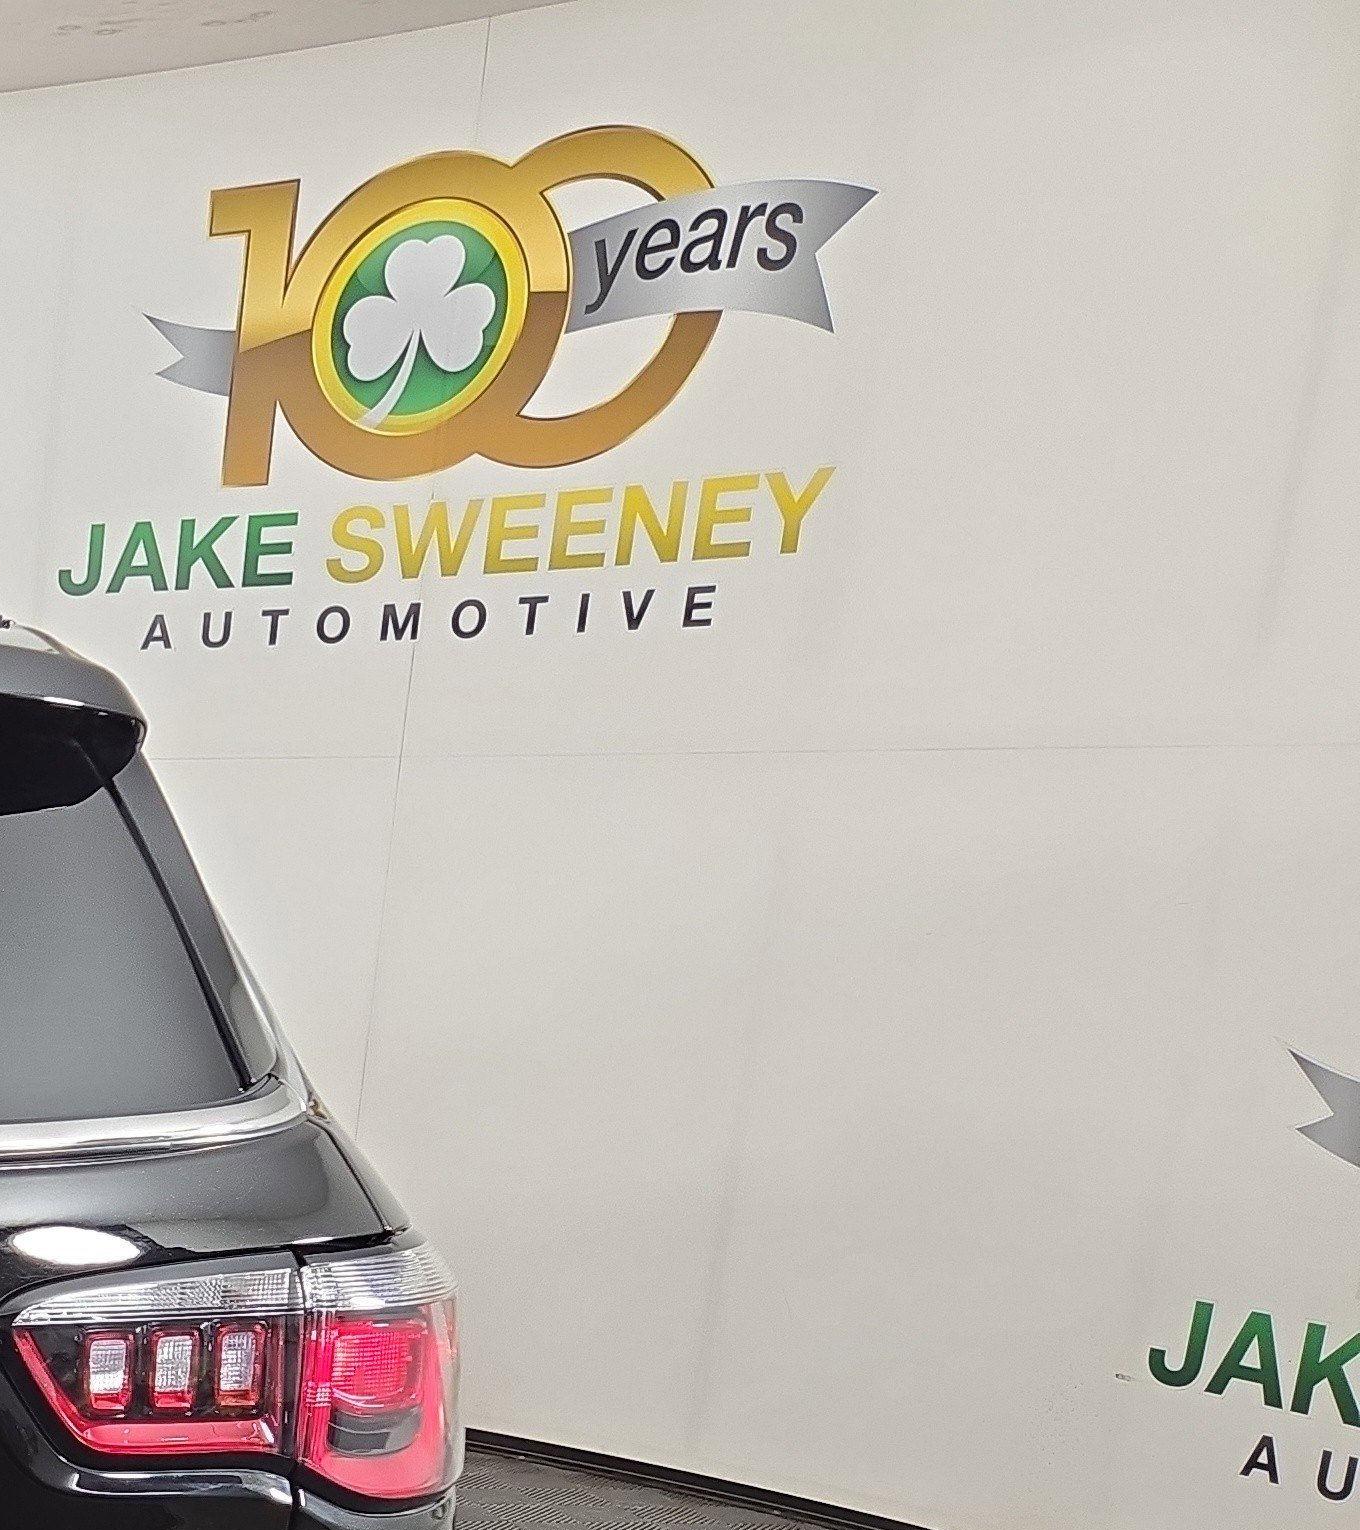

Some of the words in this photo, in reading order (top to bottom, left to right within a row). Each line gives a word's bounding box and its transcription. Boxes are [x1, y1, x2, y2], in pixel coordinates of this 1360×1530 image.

[583, 202, 805, 315] years
[59, 511, 299, 598] JAKE
[326, 466, 837, 585] SWEENEY
[141, 585, 718, 651] AUTOMOTIVE
